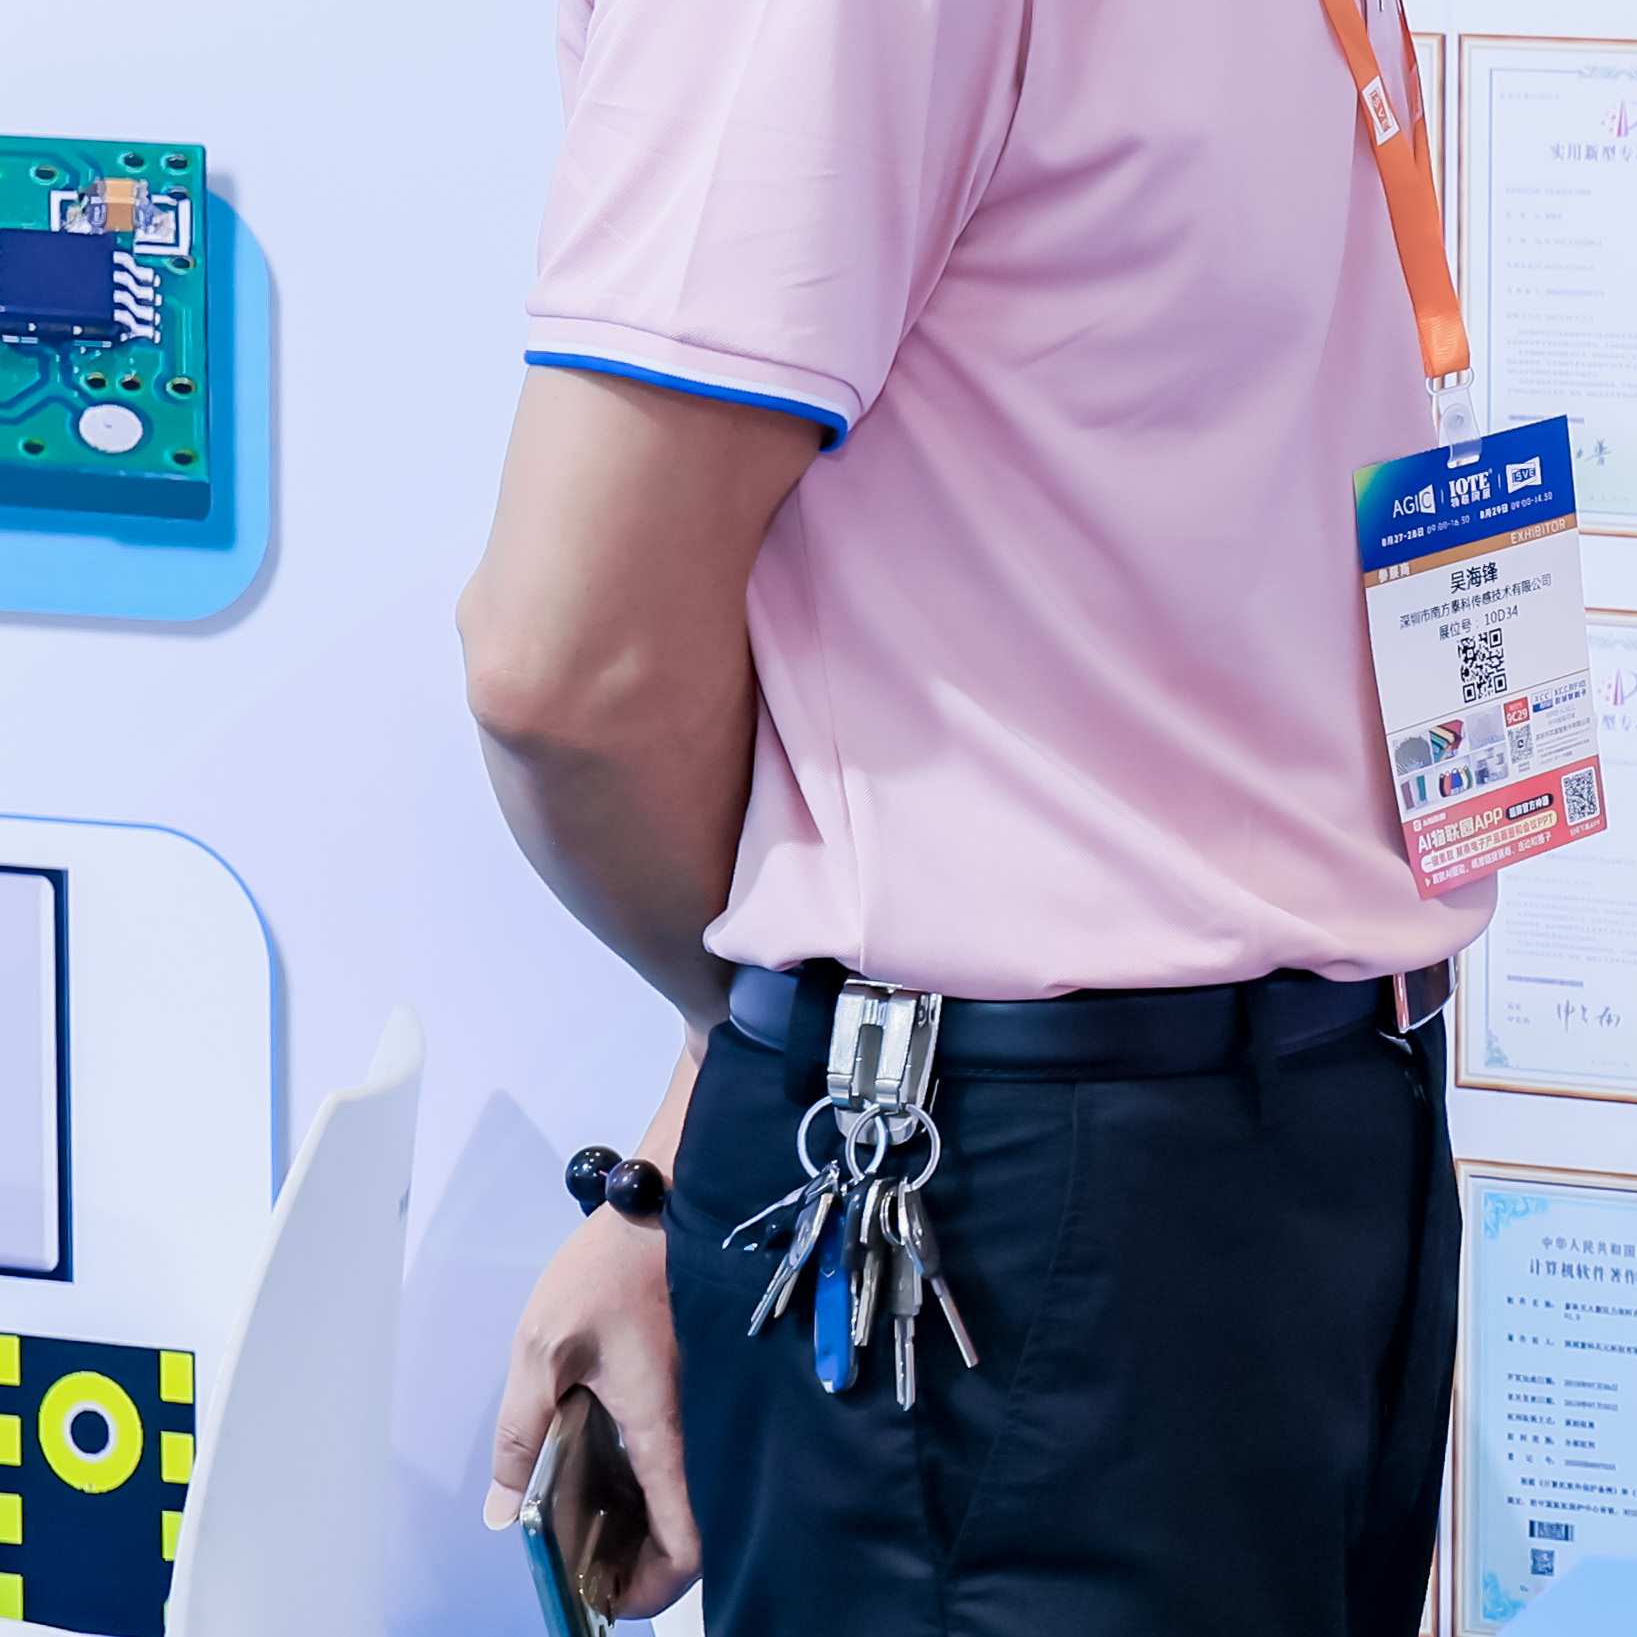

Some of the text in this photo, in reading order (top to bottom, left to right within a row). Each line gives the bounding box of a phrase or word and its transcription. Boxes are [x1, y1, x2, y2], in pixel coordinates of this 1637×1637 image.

[1448, 471, 1491, 498] IOTE
[1392, 483, 1436, 519] AGIC
[1510, 518, 1567, 545] EXHIBITOR
[1450, 561, 1498, 595] 吴海锋
